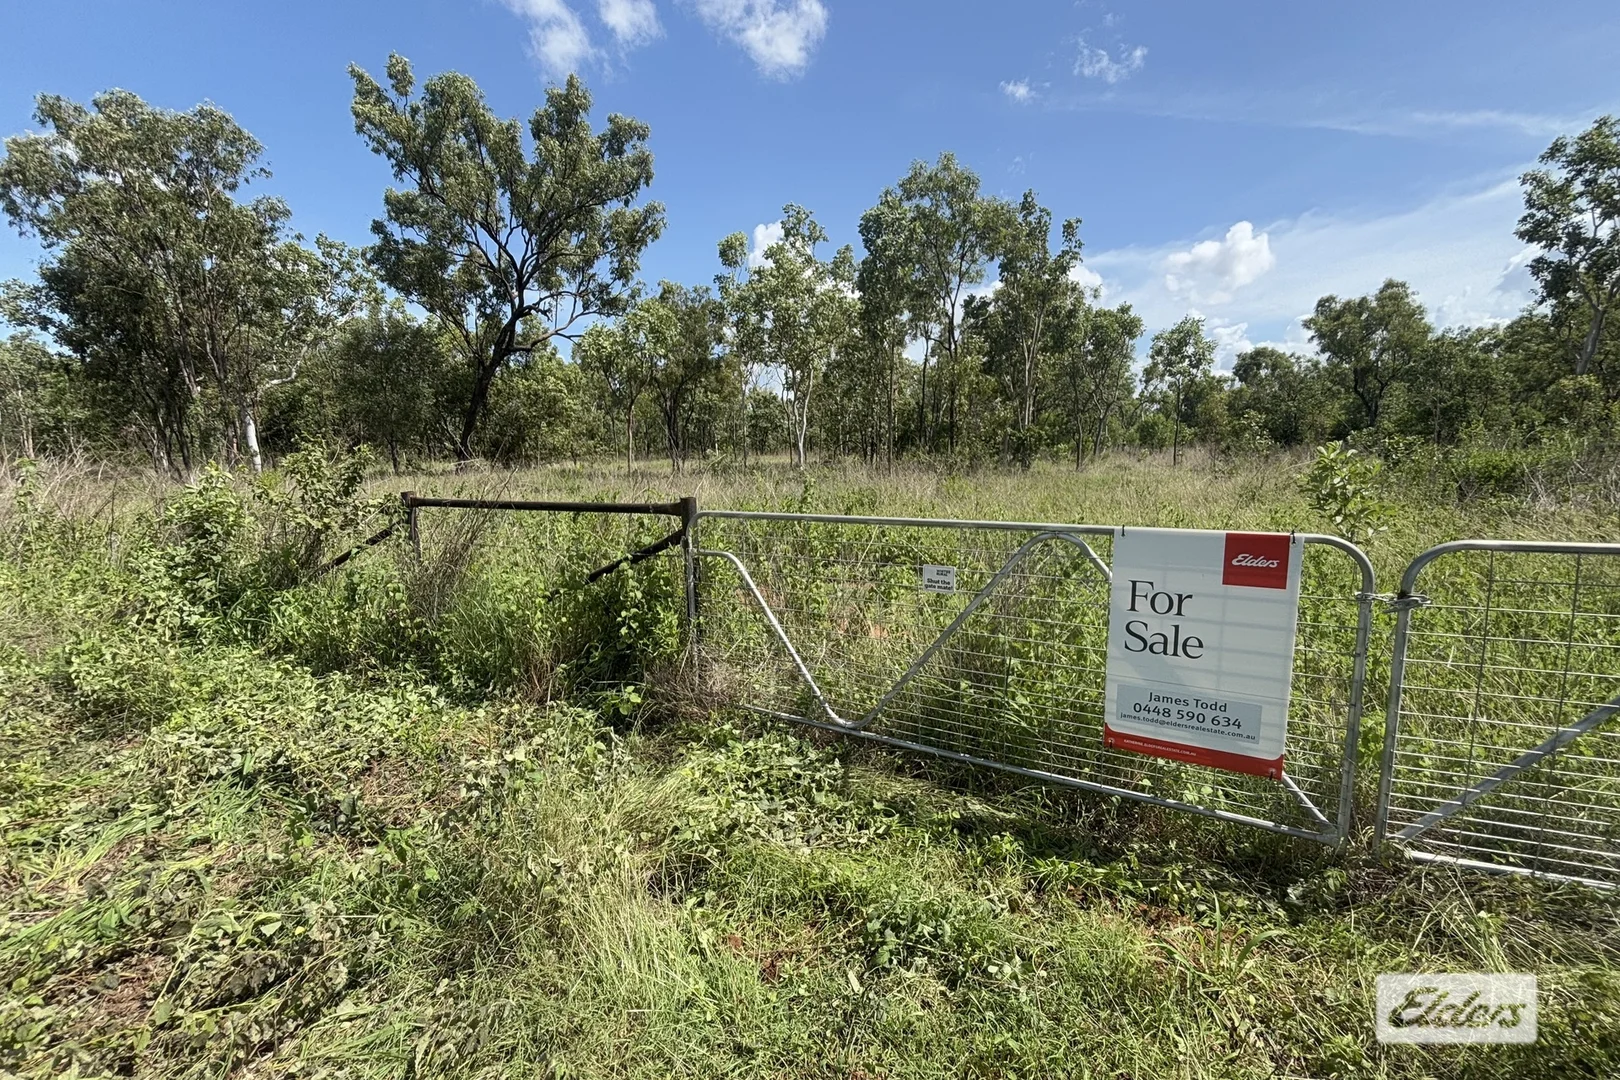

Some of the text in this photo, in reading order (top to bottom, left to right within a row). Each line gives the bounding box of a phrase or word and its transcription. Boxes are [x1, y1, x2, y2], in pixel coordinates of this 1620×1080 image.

[1231, 553, 1280, 568] Elders
[1126, 579, 1194, 617] For
[1124, 619, 1205, 660] Sale
[1133, 702, 1242, 730] 0448 590 634
[1148, 691, 1228, 713] James Todd
[1120, 712, 1256, 741] james.todd@eldersrealestate.com.au
